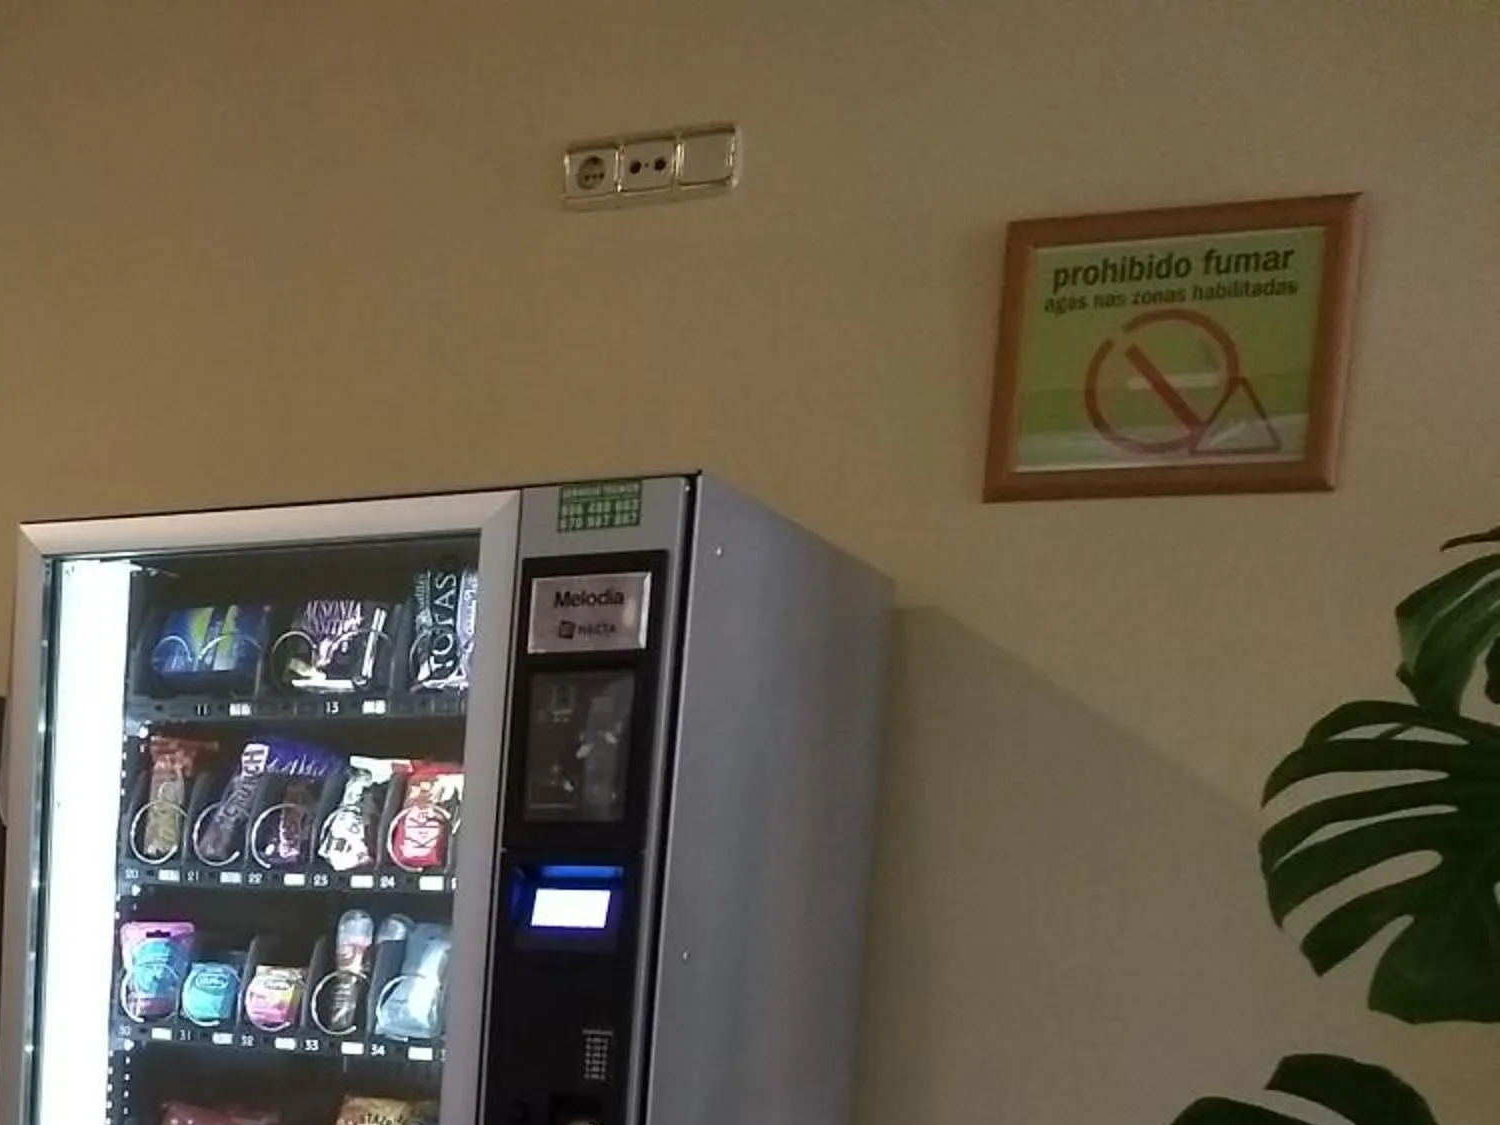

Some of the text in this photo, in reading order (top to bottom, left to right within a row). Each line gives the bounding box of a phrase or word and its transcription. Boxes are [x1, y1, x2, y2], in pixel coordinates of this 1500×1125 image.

[1052, 248, 1296, 294] prohibido fumar
[1131, 287, 1187, 306] zonas
[1192, 277, 1300, 300] habilitadas
[554, 589, 625, 609] Melodia
[179, 1029, 191, 1041] 31
[304, 1039, 319, 1051] 33
[371, 1043, 386, 1057] 34
